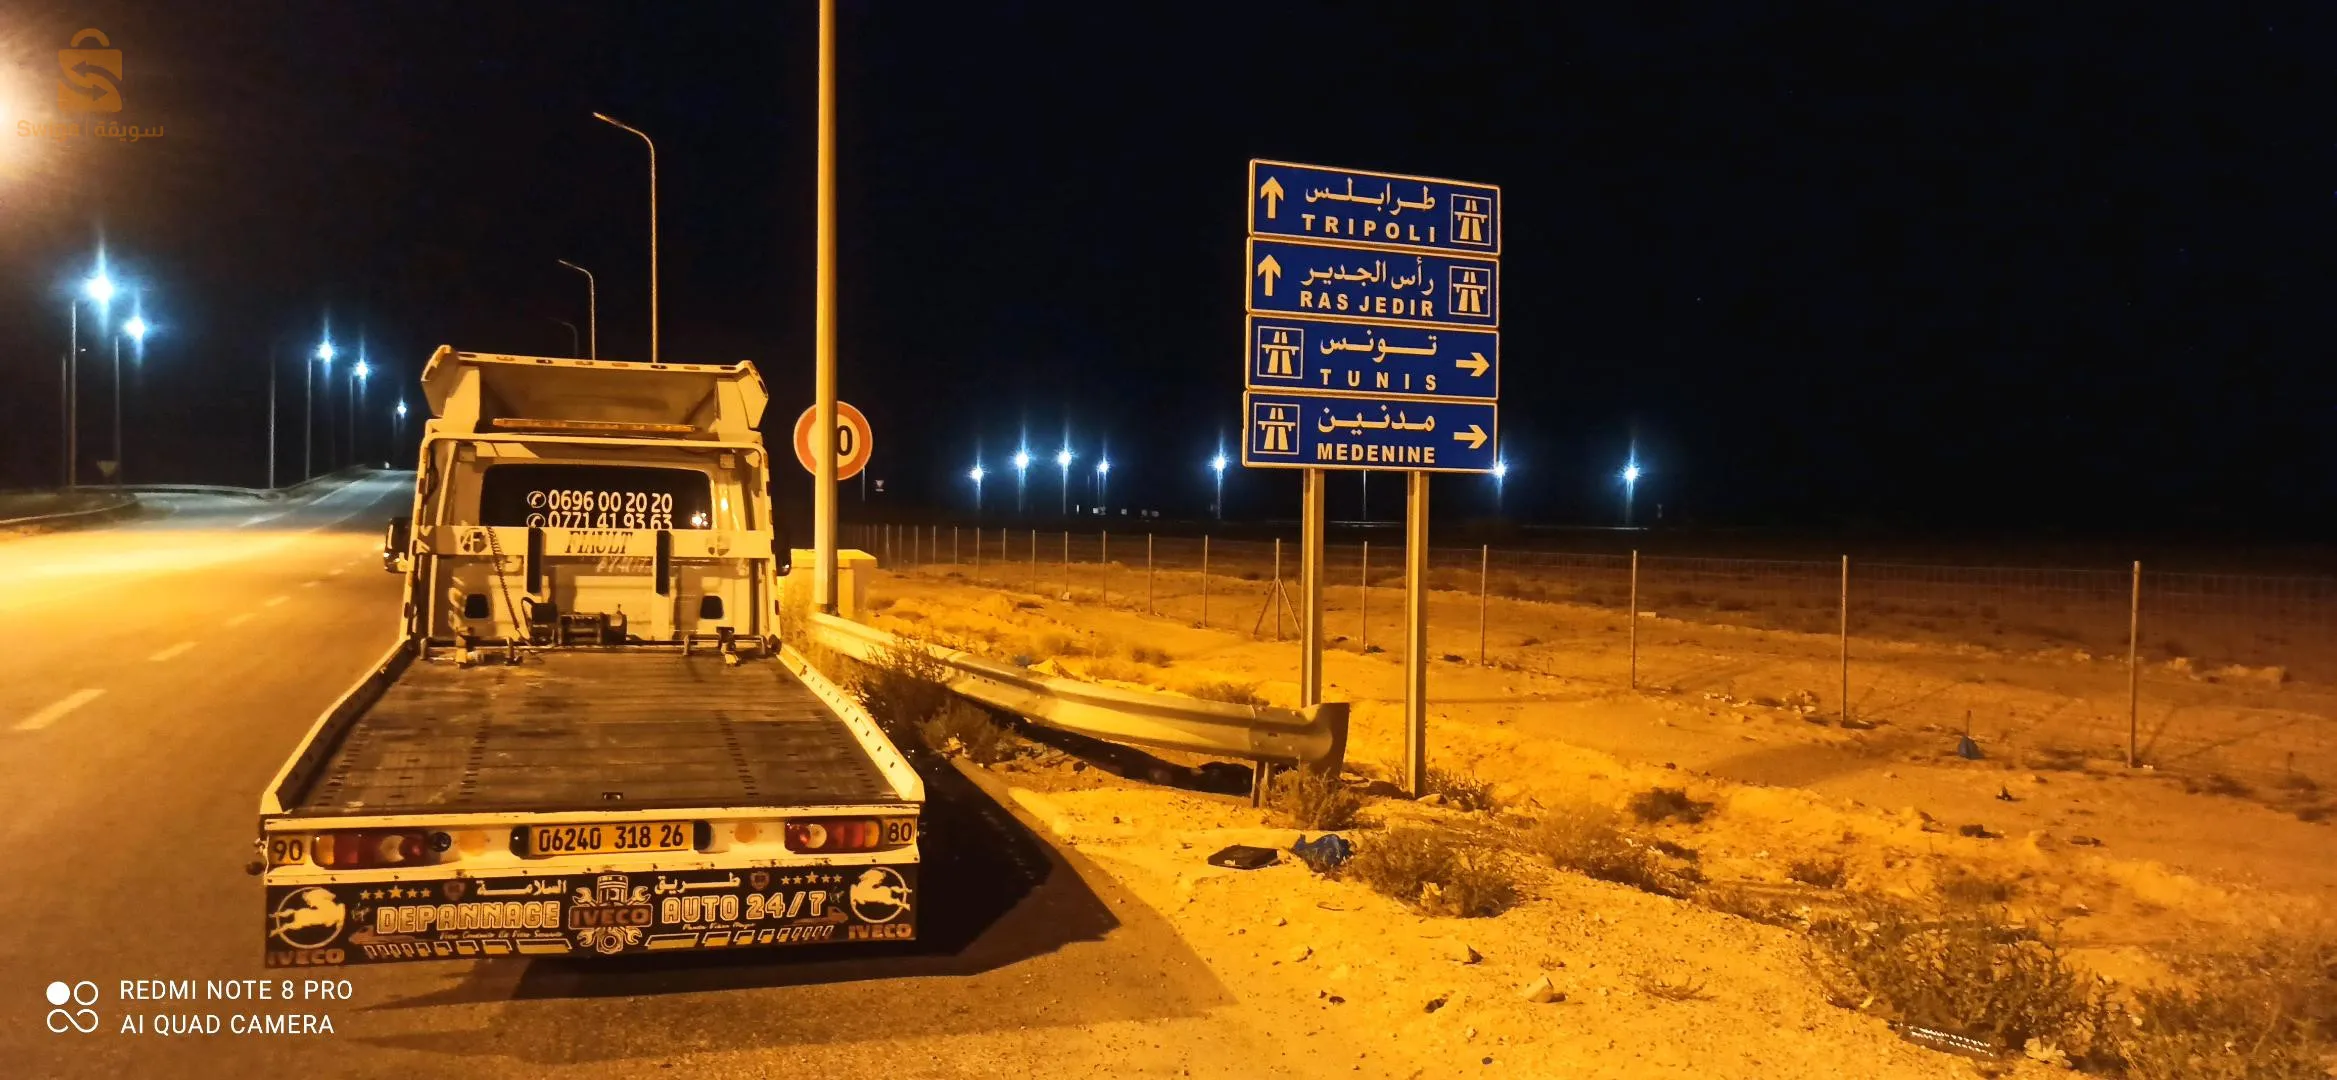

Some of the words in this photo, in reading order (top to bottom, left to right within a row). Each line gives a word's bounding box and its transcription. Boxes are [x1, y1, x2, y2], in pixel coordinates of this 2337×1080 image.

[1304, 178, 1436, 216] طرابلس
[1302, 213, 1436, 243] TRIPOLI
[1301, 259, 1387, 287] الجدير
[1391, 257, 1435, 296] رأس
[1300, 290, 1349, 312] RAS
[1359, 295, 1434, 318] JEDIR
[1320, 329, 1438, 363] تونس
[1320, 368, 1437, 391] TUNIS
[1317, 404, 1436, 436] مدنين
[1317, 442, 1436, 464] MEDENINE
[548, 489, 594, 512] 0696
[598, 491, 621, 513] 00
[625, 492, 648, 513] 20
[651, 493, 673, 514] 20
[548, 511, 590, 529] 0771
[596, 512, 617, 529] 41
[538, 827, 601, 852] 06240
[614, 825, 651, 849] 318
[659, 824, 684, 848] 26
[887, 822, 912, 842] 80
[274, 839, 303, 862] 90
[476, 879, 567, 896] السلامة
[377, 901, 561, 933] DEPANNAGE
[661, 895, 739, 924] AUTO
[746, 890, 827, 920] 24/7
[572, 908, 650, 926] IVECO
[849, 923, 912, 940] IVECO
[268, 949, 345, 966] IVECO
